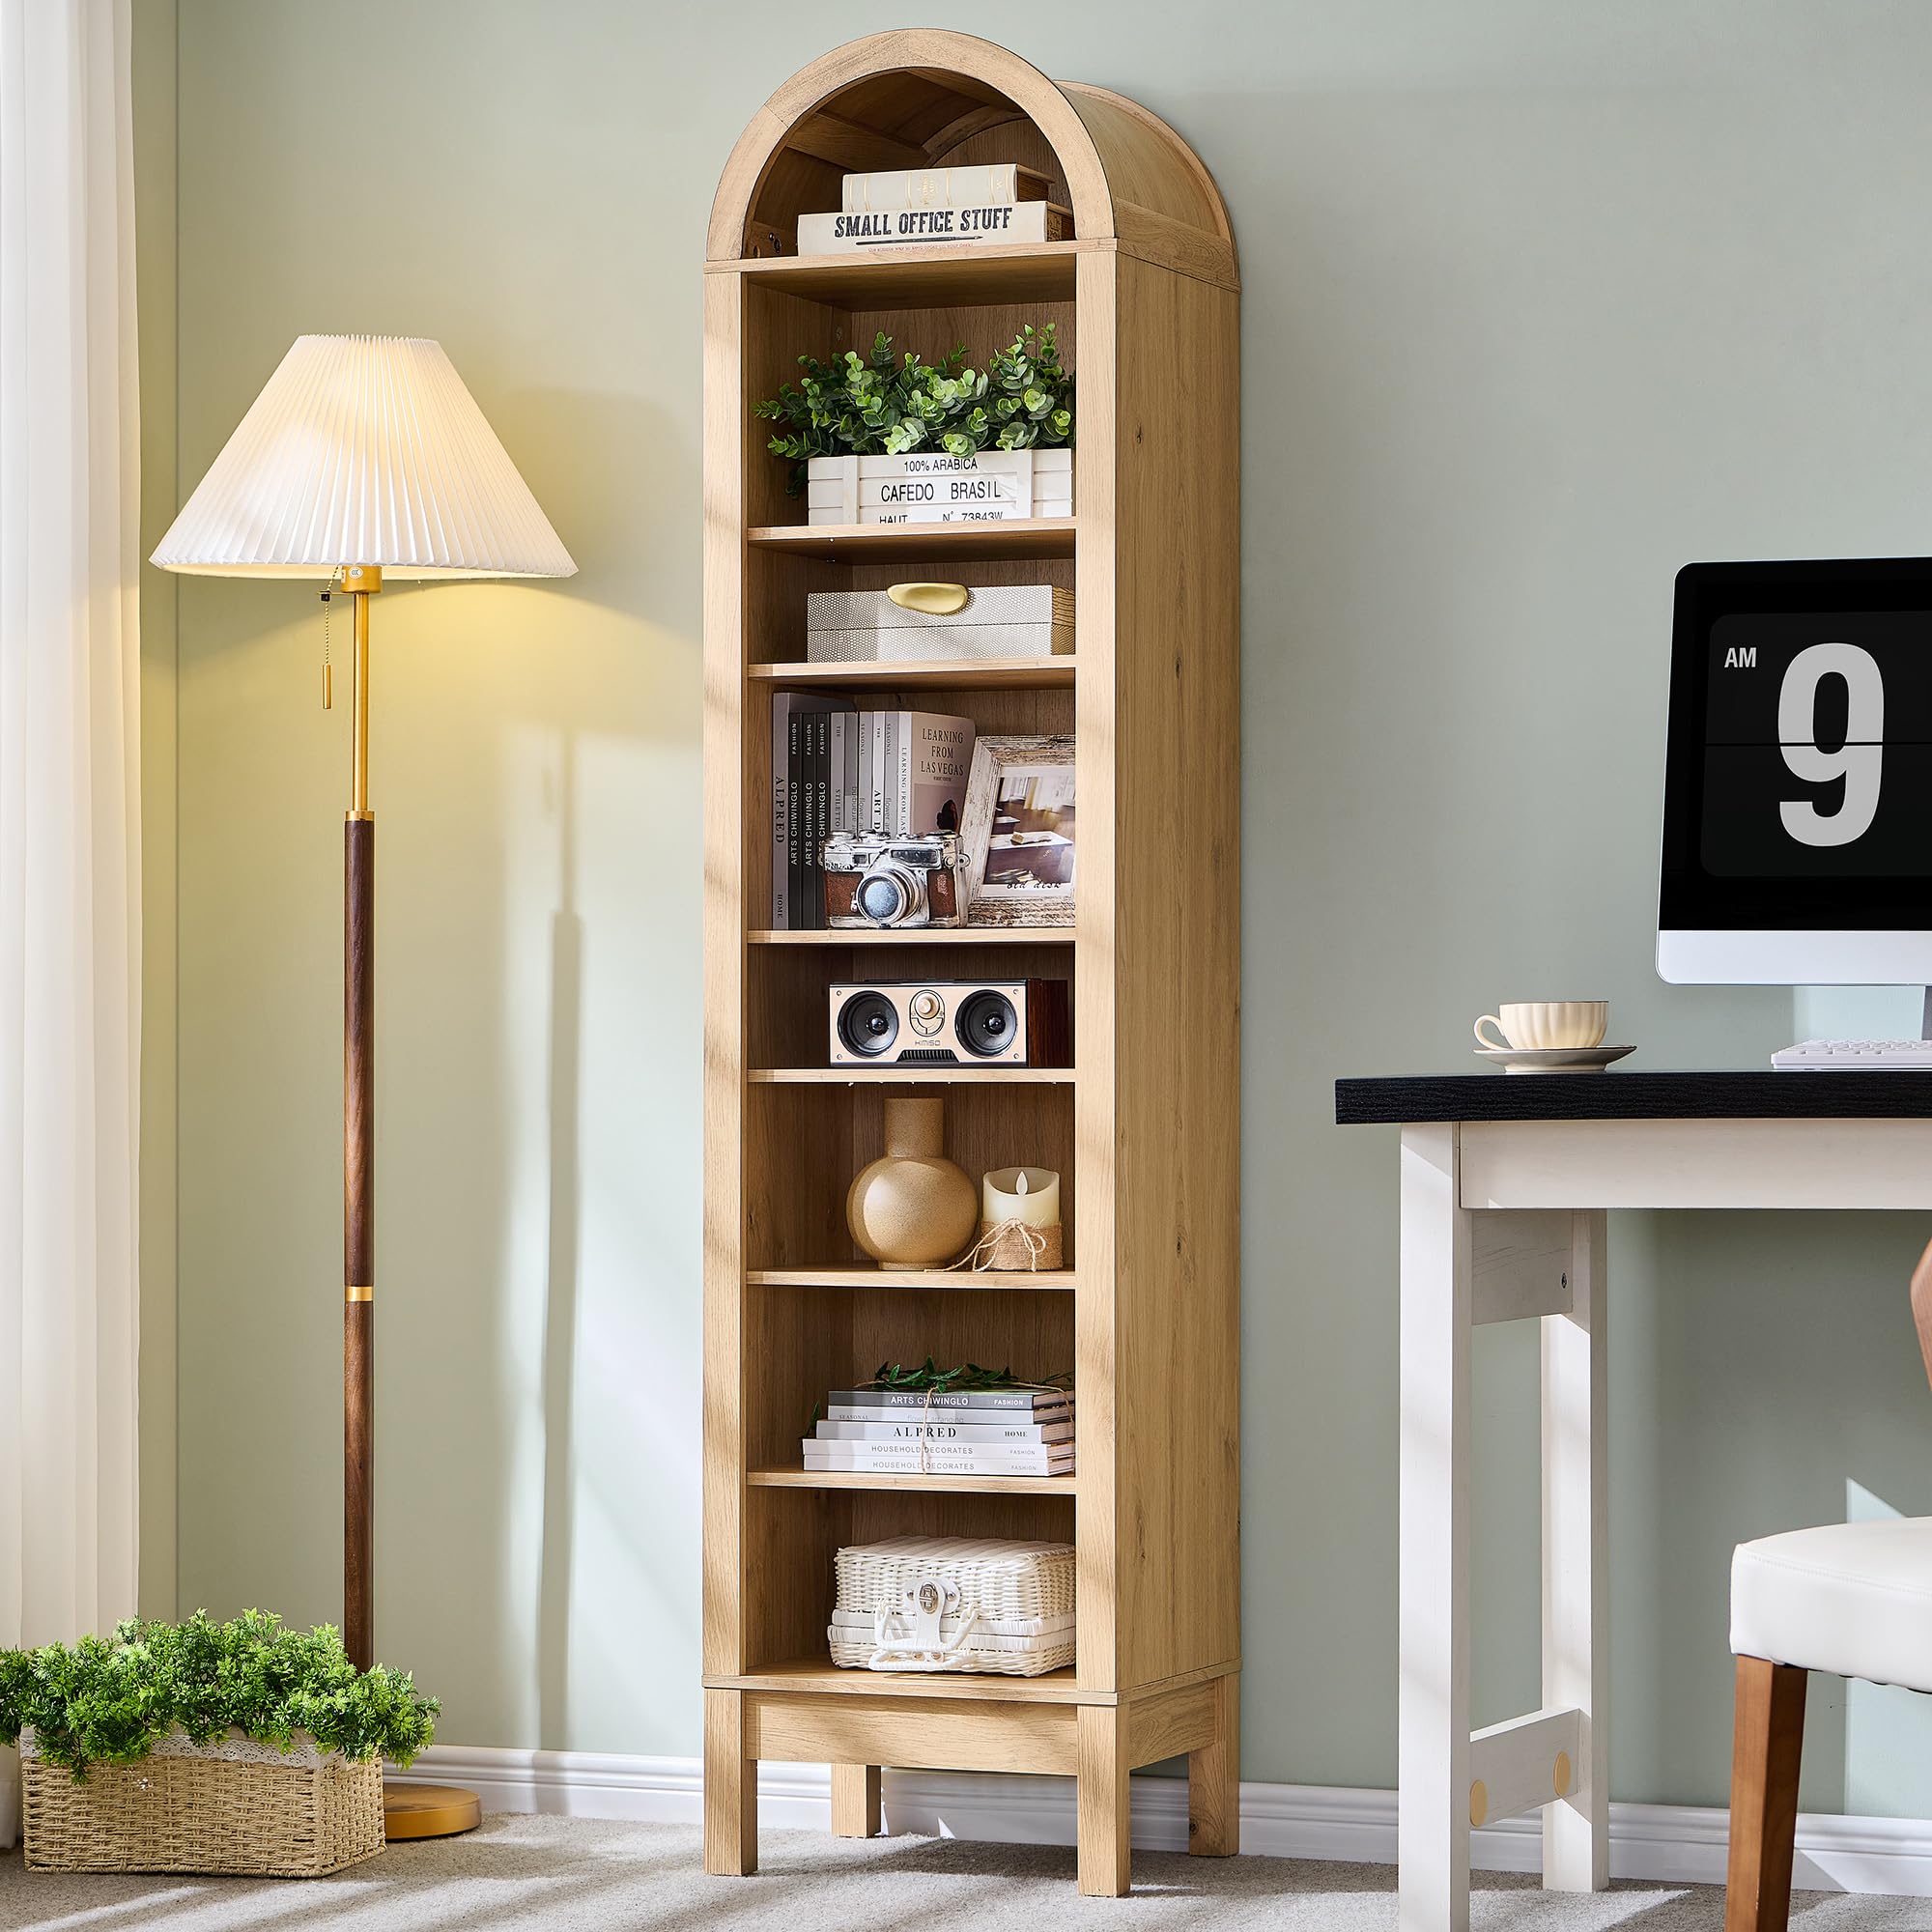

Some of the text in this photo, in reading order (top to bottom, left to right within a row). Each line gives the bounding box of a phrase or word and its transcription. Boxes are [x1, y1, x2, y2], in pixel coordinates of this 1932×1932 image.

[835, 207, 1012, 238] SMALL OFFICE STUFF
[904, 458, 978, 472] 100% ARABICA
[881, 481, 1001, 502] CAFEDO BRASIL
[1723, 647, 1756, 668] AM
[922, 728, 964, 744] LEARNING
[931, 745, 953, 759] FROM
[1777, 642, 1885, 847] 9
[921, 760, 964, 777] LAS VEGAS
[776, 776, 785, 843] ALPRED
[873, 789, 882, 816] ART
[890, 1396, 914, 1405] ARTS
[893, 1427, 957, 1438] ALPRED
[924, 1446, 974, 1455] DECORATES
[872, 1461, 923, 1469] HOUSEHOLD
